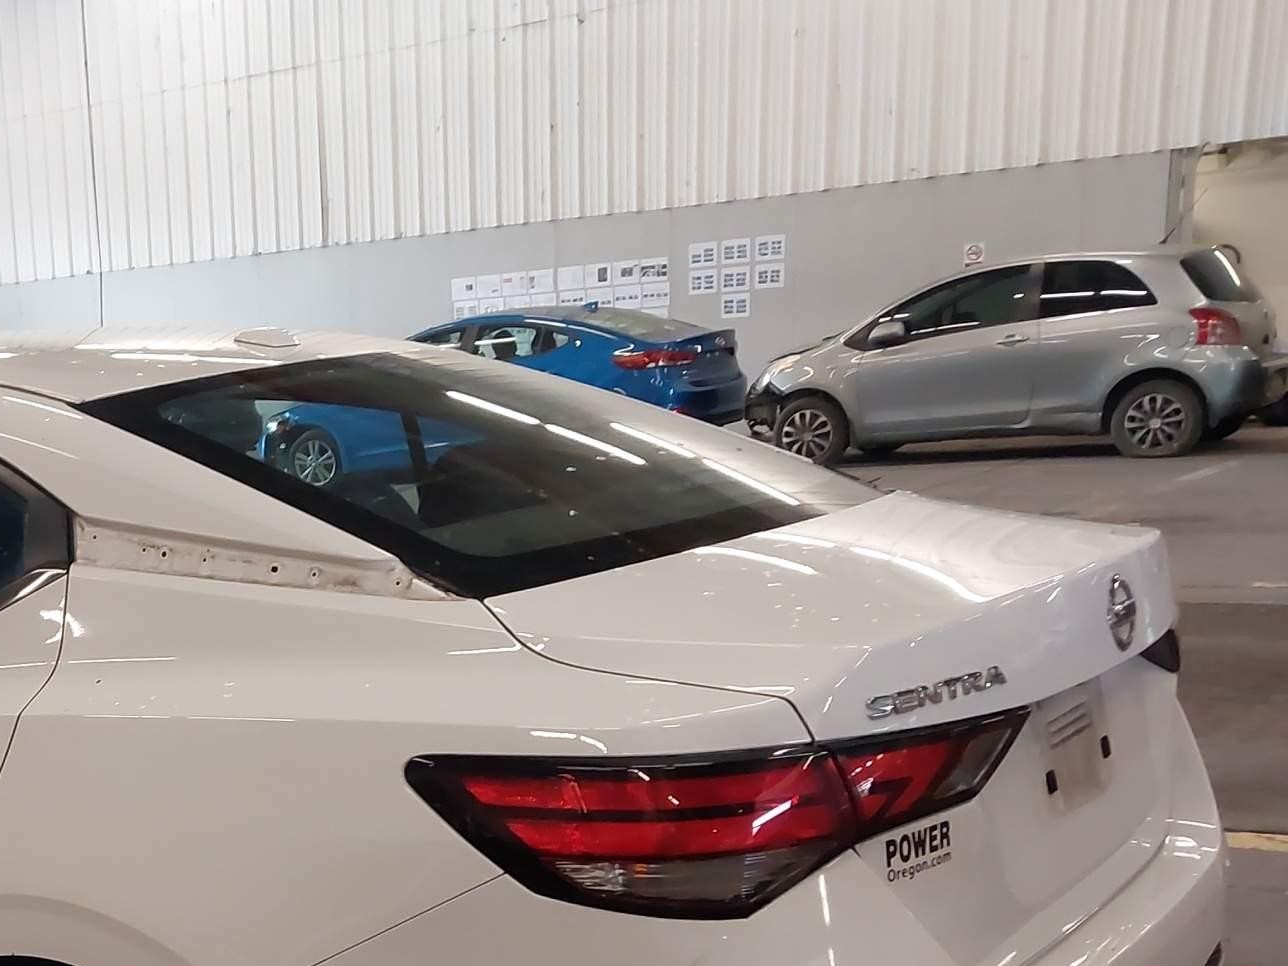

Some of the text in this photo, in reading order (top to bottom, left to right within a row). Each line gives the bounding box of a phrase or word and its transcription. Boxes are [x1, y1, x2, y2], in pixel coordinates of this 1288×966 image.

[865, 665, 1008, 720] SENTRA
[885, 820, 951, 868] POWER
[887, 851, 952, 882] Oregon.com
